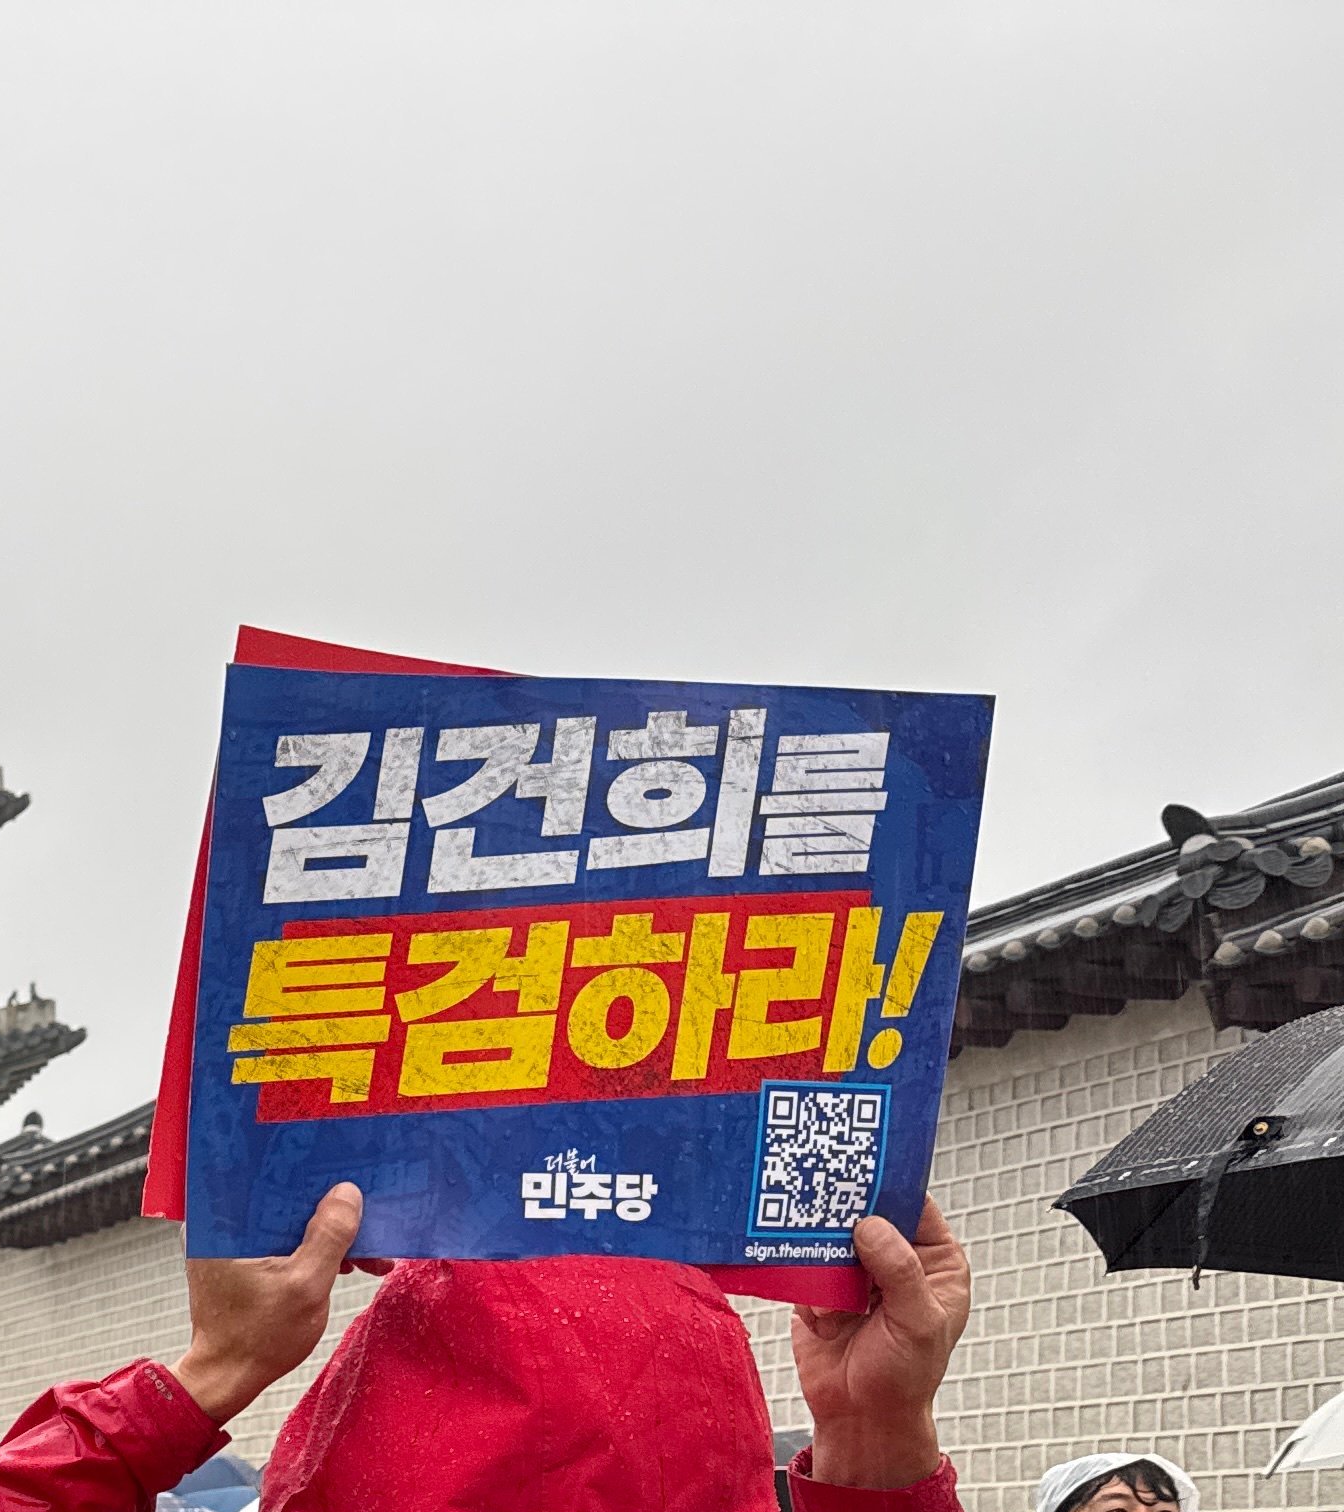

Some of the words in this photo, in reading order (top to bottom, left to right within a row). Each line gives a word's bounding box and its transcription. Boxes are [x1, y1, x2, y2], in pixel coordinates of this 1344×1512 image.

[262, 708, 890, 904] 김건희를
[227, 907, 944, 1104] 특검하라!
[521, 1172, 658, 1222] 민주당
[543, 1149, 596, 1176] 더불어
